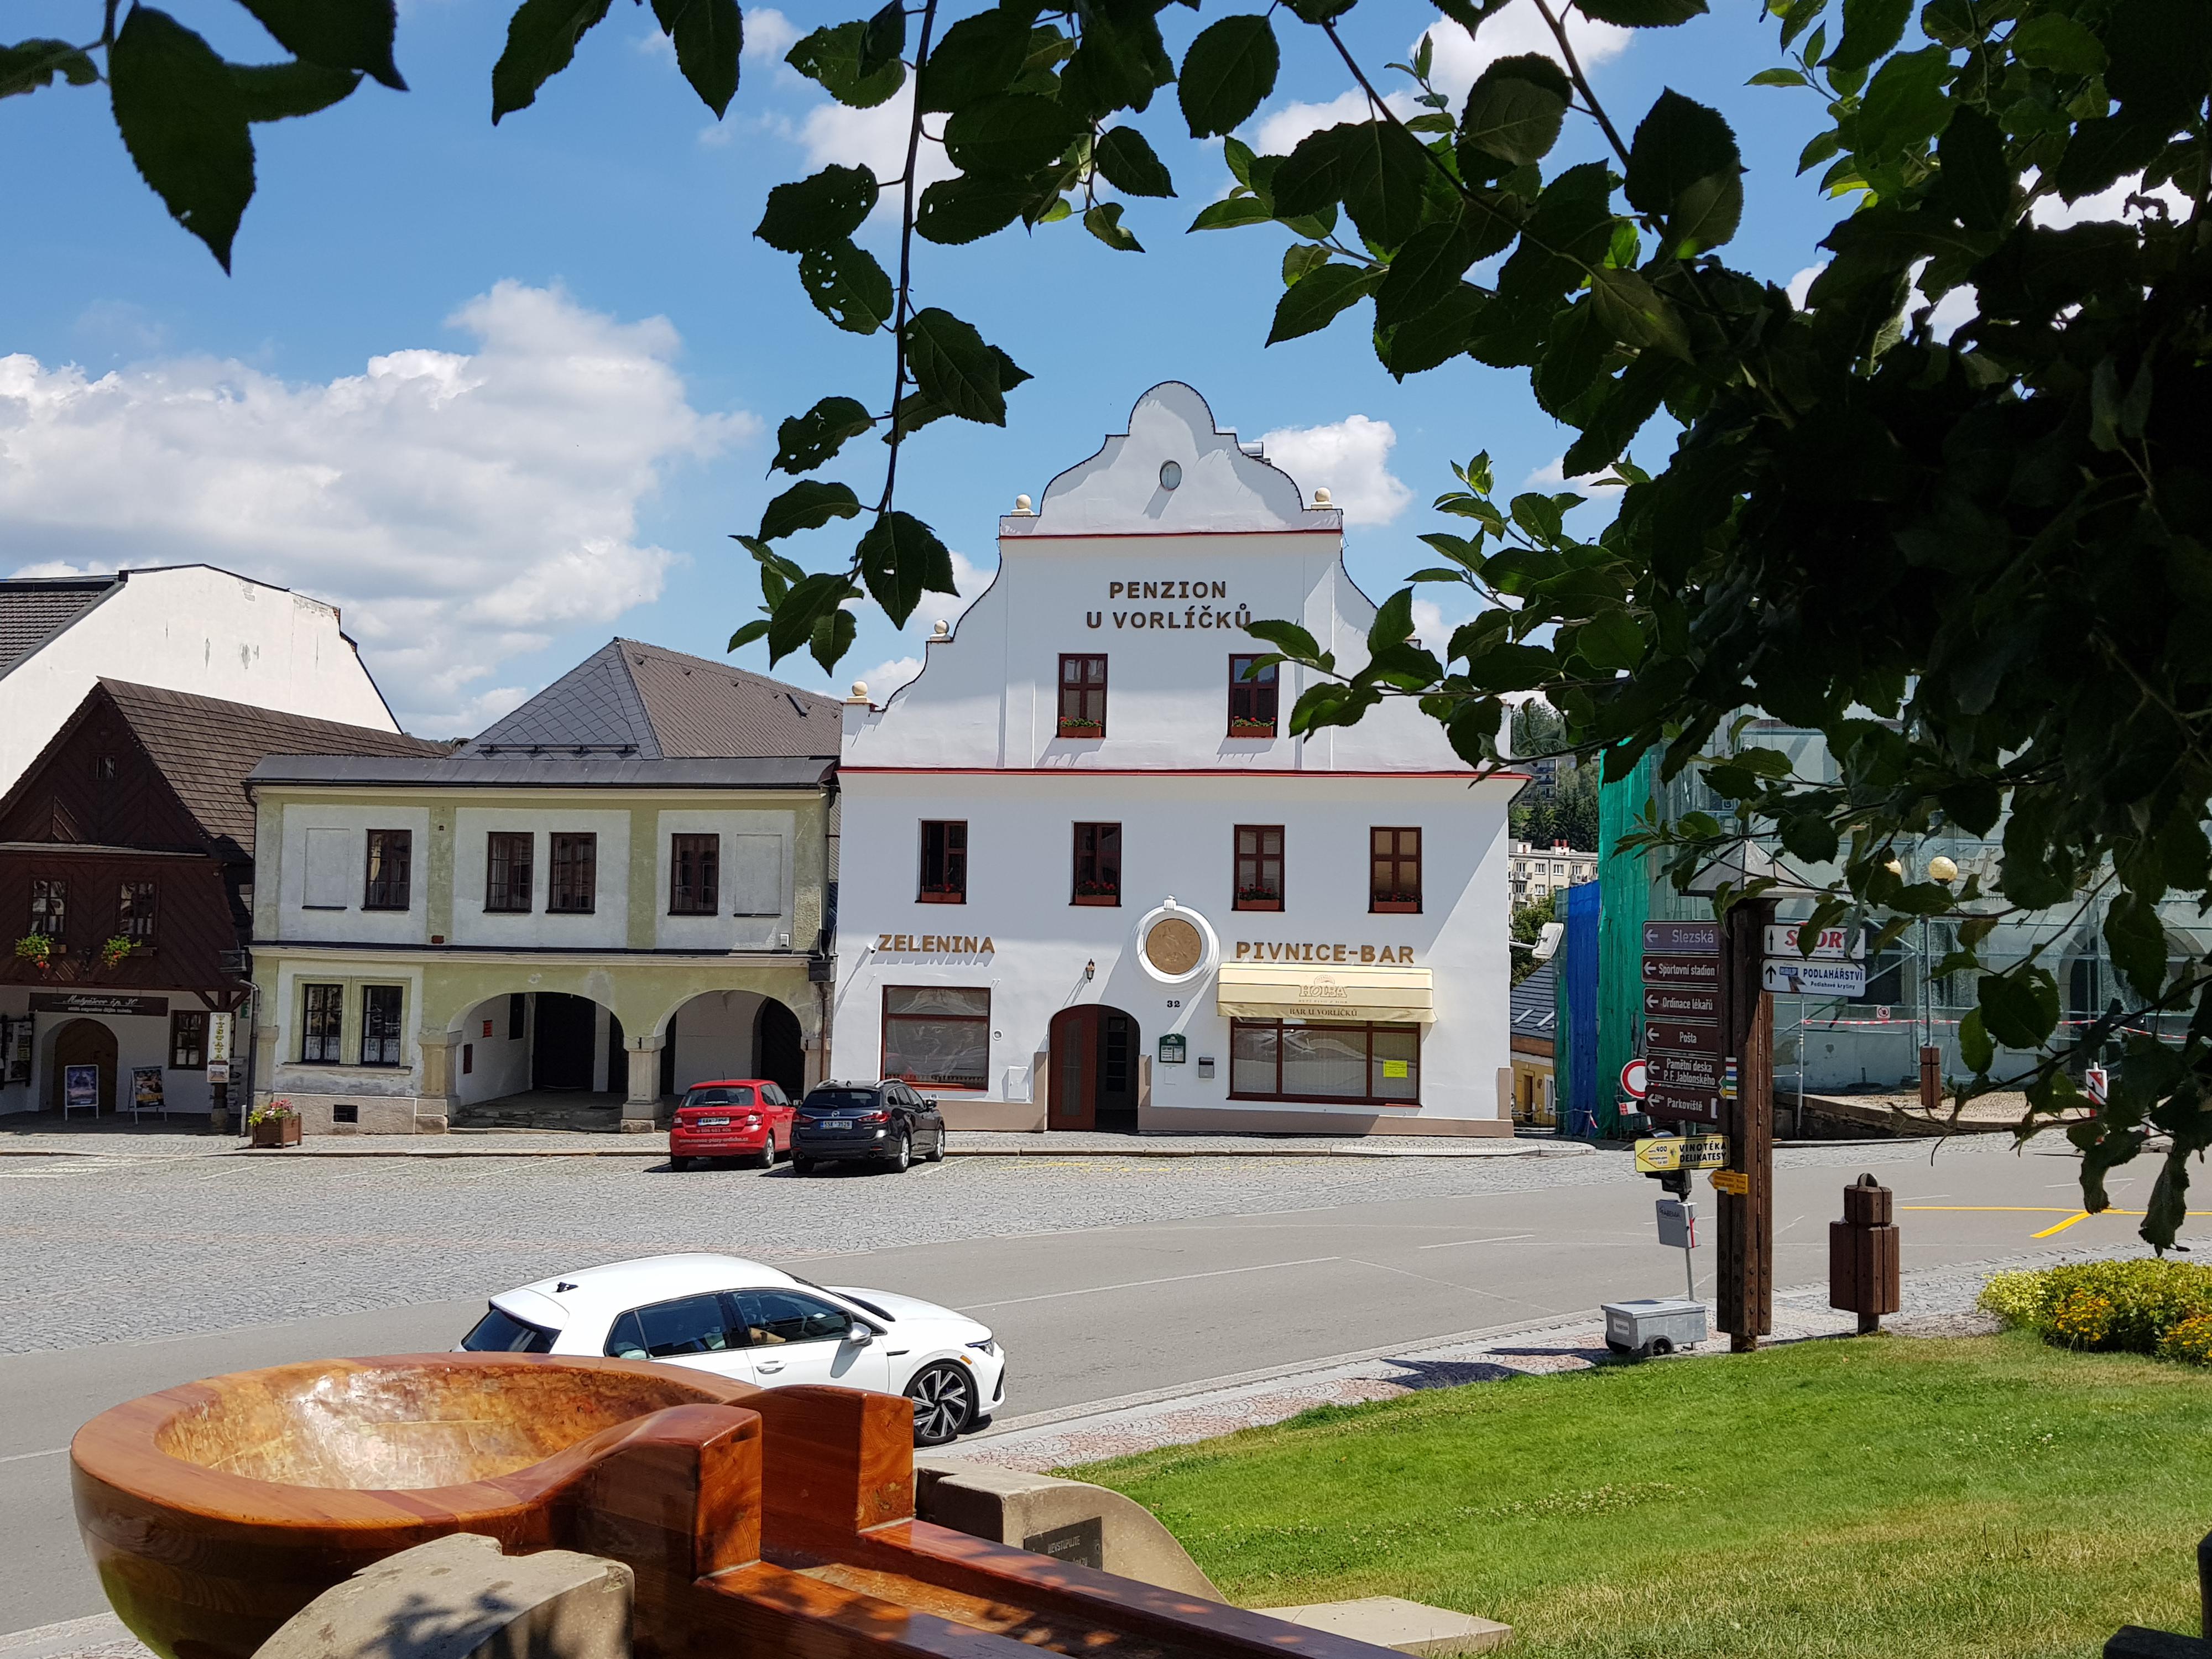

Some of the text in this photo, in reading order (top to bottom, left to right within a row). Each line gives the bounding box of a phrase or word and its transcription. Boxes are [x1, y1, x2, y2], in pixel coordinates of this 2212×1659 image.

[1109, 581, 1226, 599] PENZION
[1086, 603, 1251, 629] U VORLÍČKŮ
[1672, 929, 1714, 943] Slezská
[1784, 930, 1850, 948] SOR
[878, 934, 995, 953] ZELENINA
[1236, 941, 1415, 964] PIVNICE-BAR
[1658, 963, 1715, 977] Sportovní stadion
[1803, 967, 1863, 981] PODLAHÁŘSTVÍ
[1299, 985, 1348, 998] HOLBA
[1167, 1000, 1180, 1008] 32
[1662, 997, 1713, 1010] Ordinace lékařů
[1317, 1007, 1358, 1016] VORLÍČKŮ
[1679, 1031, 1697, 1044] Pošta
[1666, 1057, 1713, 1073] Pamětní deska
[1663, 1070, 1715, 1086] P. F. Jablonského
[1667, 1097, 1703, 1112] Parkoviště
[1679, 1140, 1726, 1152] VINOTÉKA
[1679, 1152, 1726, 1162] DELIKATESY
